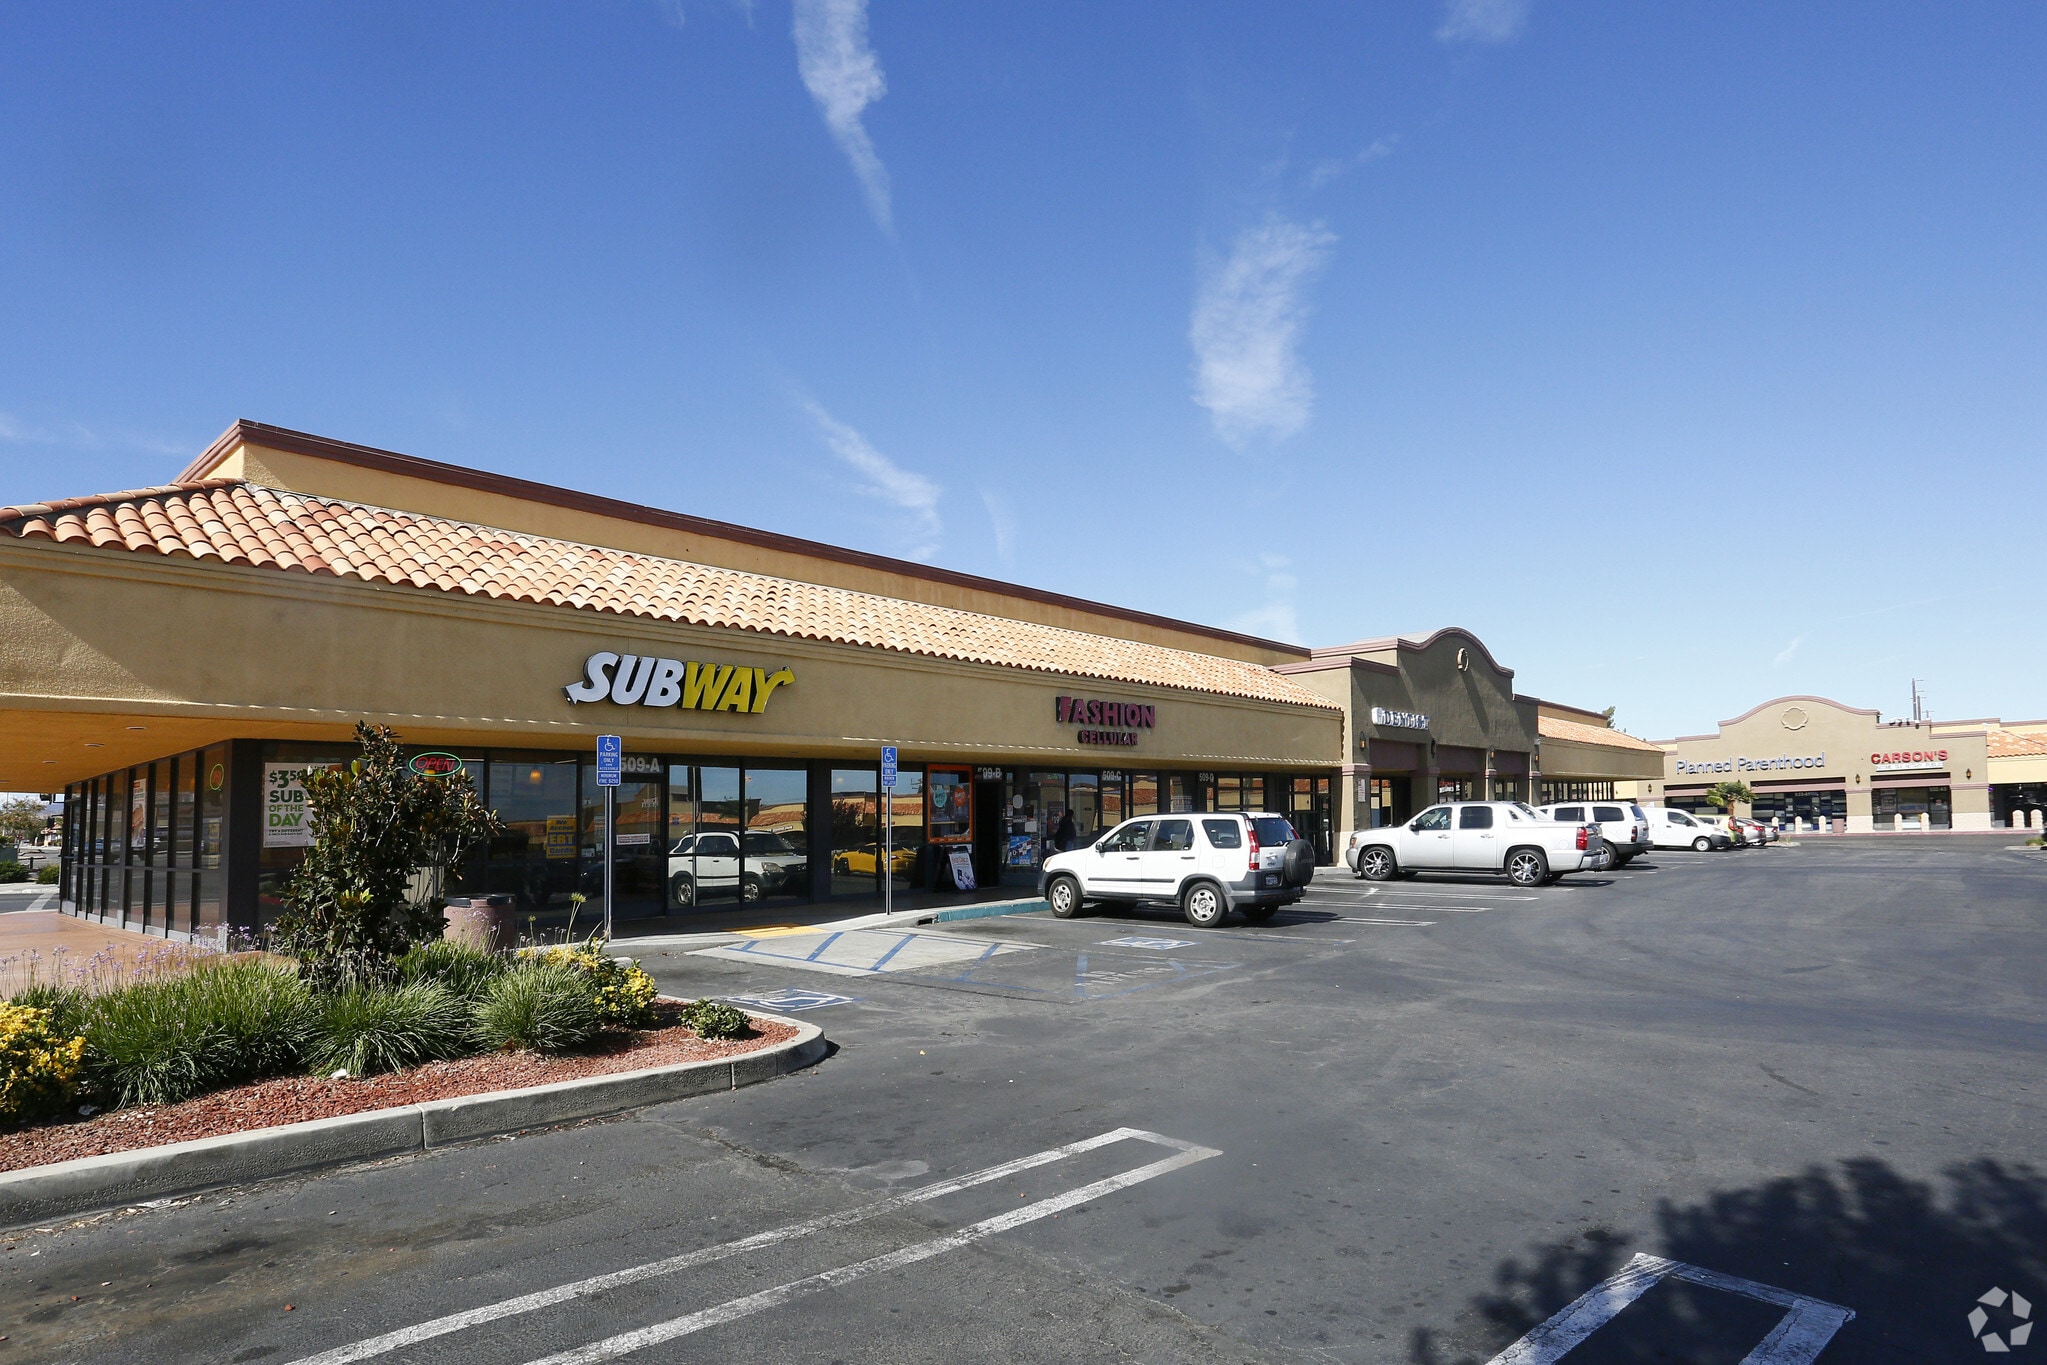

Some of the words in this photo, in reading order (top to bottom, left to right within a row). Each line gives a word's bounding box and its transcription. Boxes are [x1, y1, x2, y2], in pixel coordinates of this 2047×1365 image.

[561, 651, 796, 714] SUBWAY
[1056, 696, 1155, 728] FASHION
[1384, 710, 1430, 730] DENTIST
[1078, 730, 1138, 746] CELLULAR
[415, 756, 455, 771] OPEN
[620, 757, 660, 772] 509-A
[1676, 757, 1732, 774] Planned
[1737, 752, 1826, 772] Parenthood
[1871, 750, 1948, 764] CARSON'S
[1102, 770, 1121, 780] 509-C
[269, 790, 304, 803] SUB
[284, 804, 303, 812] THE
[269, 813, 304, 827] DAY
[549, 833, 574, 844] EBT
